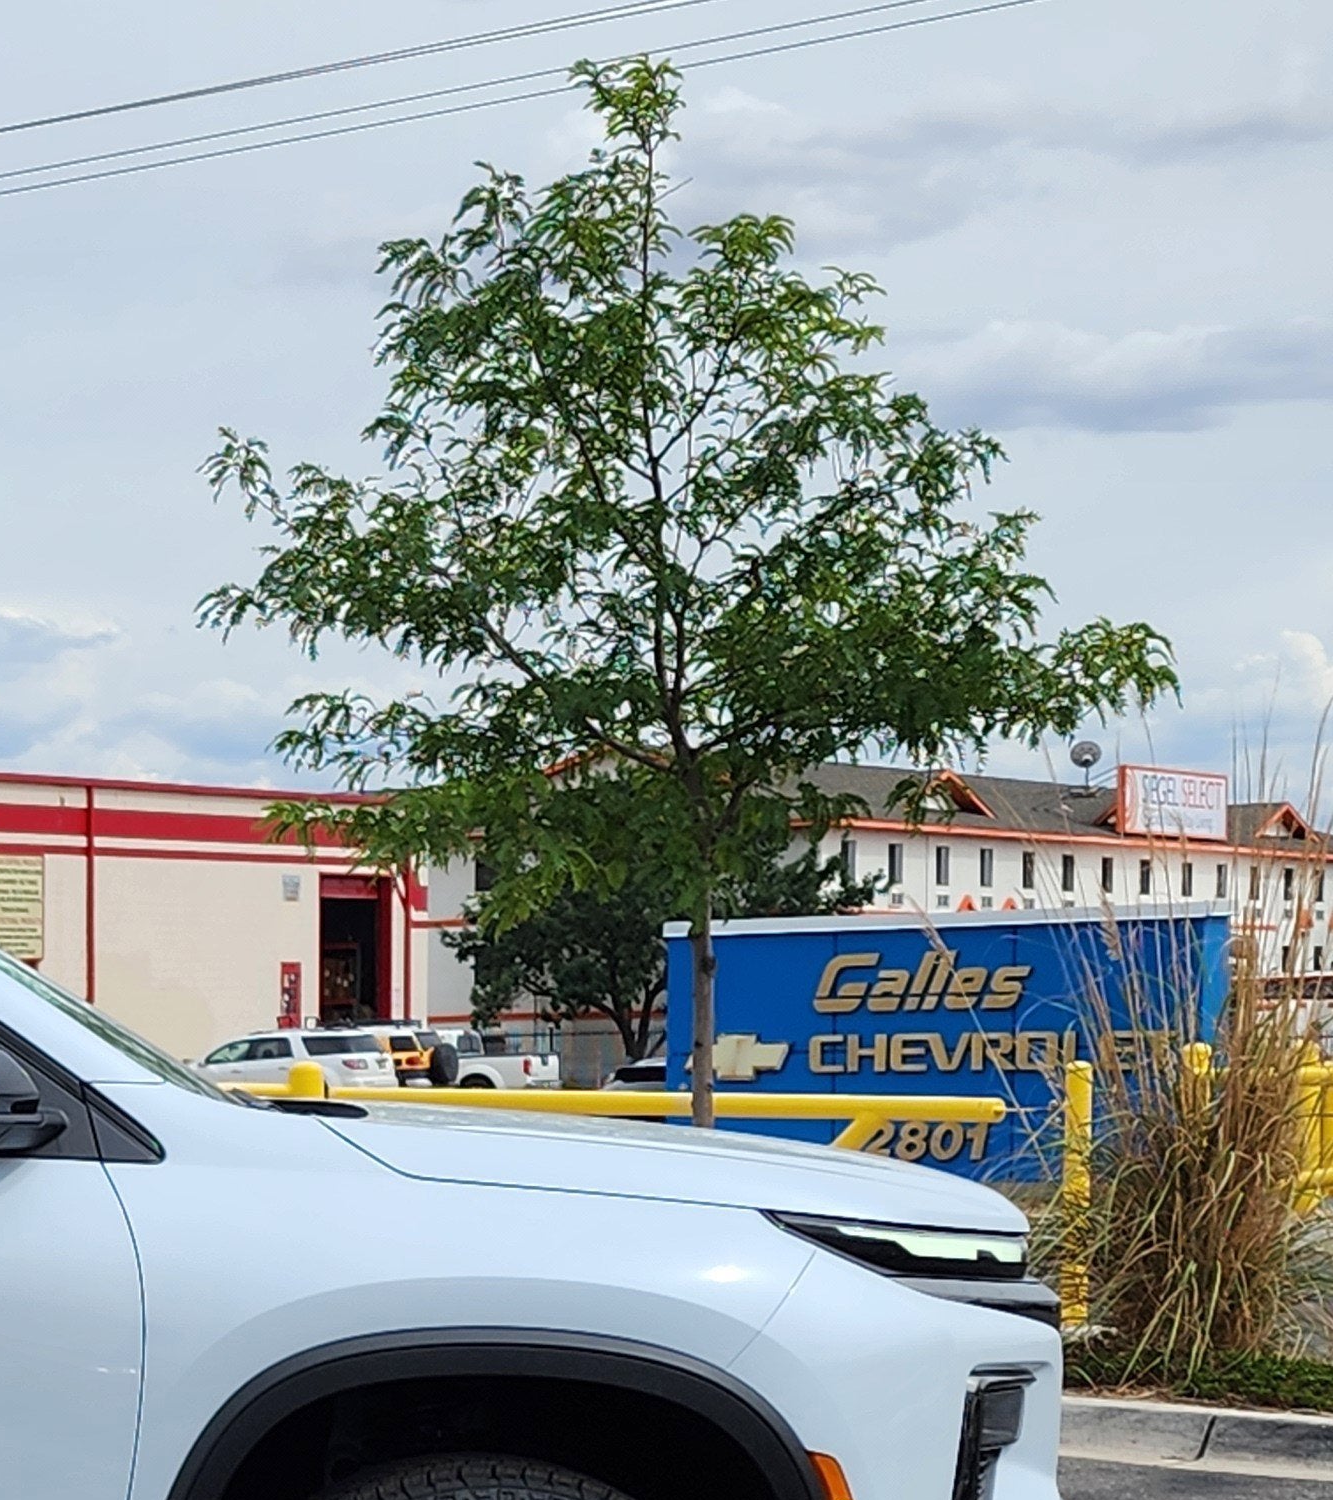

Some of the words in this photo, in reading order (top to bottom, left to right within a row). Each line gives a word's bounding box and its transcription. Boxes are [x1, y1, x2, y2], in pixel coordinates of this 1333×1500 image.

[1181, 778, 1223, 810] SELECT
[812, 948, 1031, 1014] Galles
[865, 1120, 989, 1161] 2801
